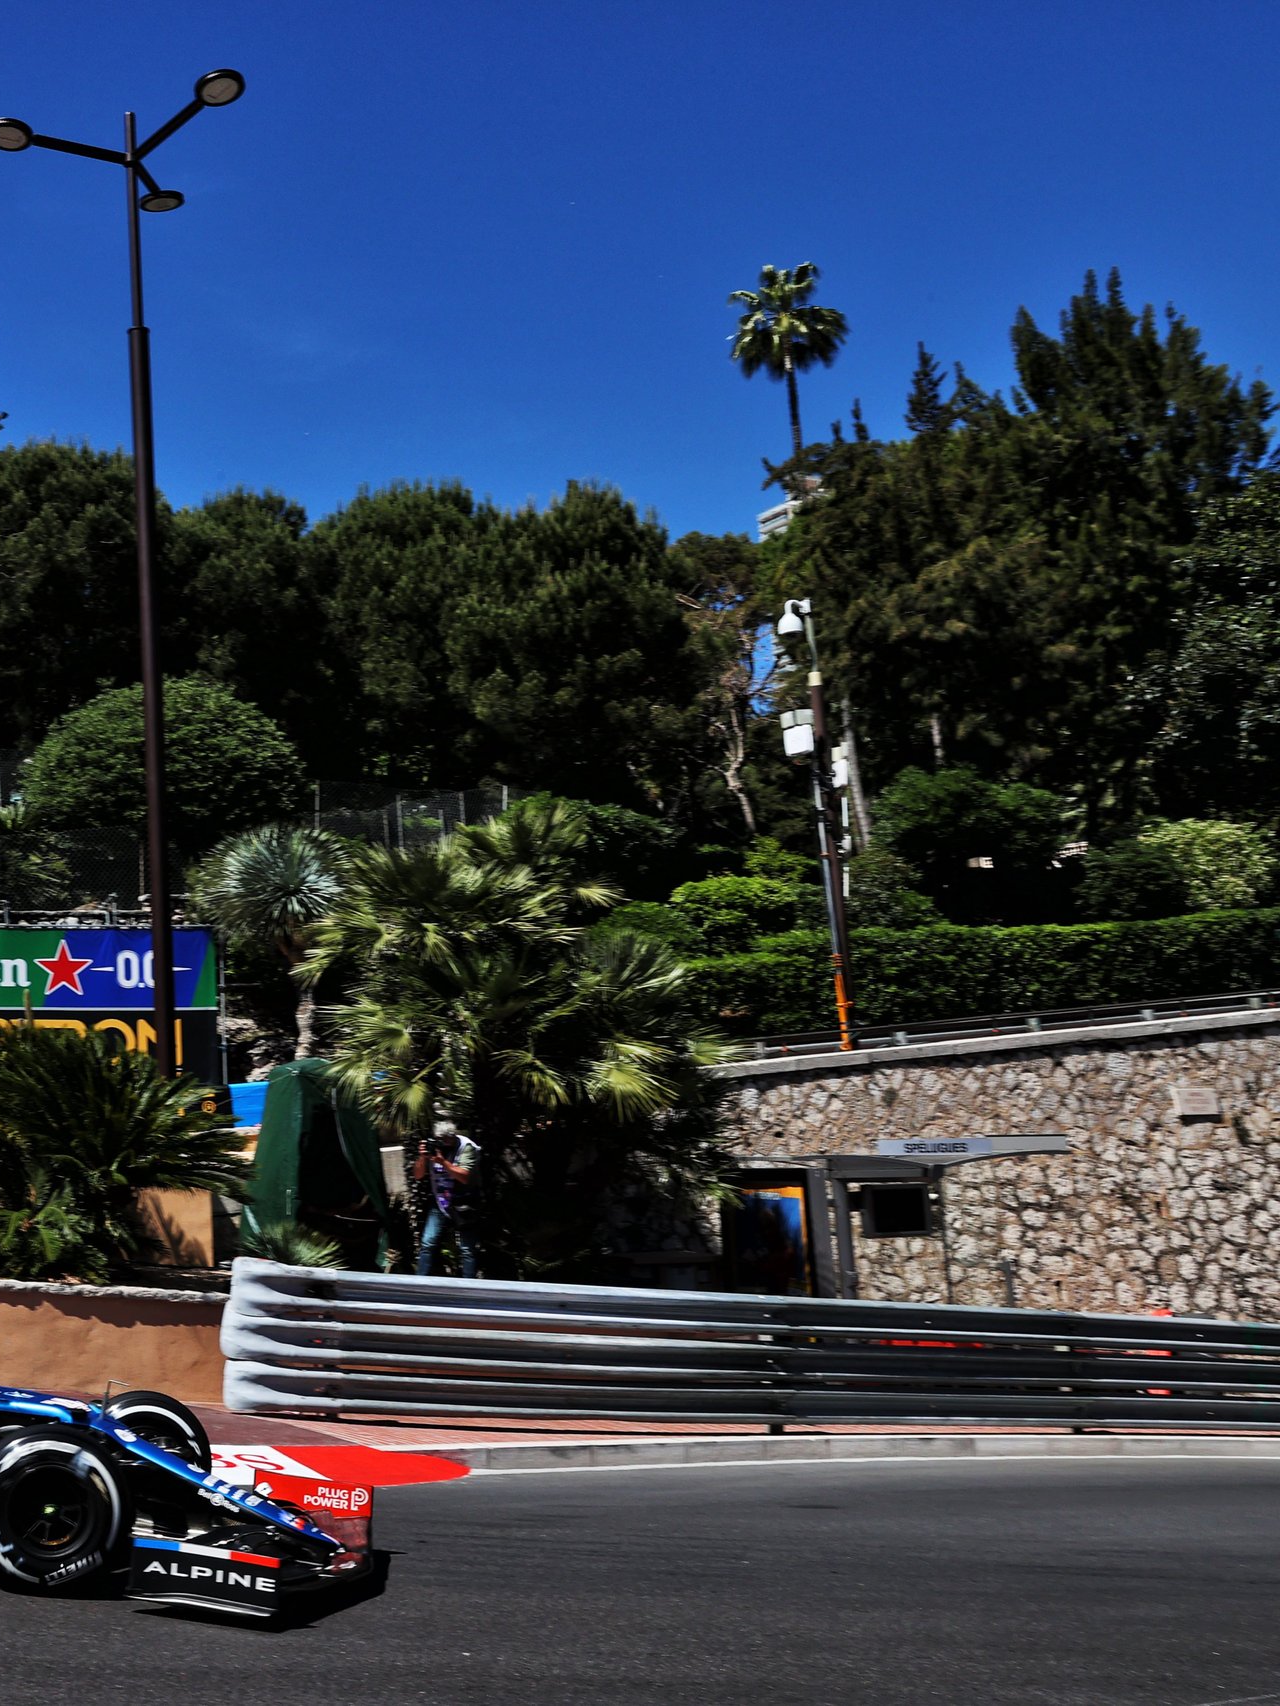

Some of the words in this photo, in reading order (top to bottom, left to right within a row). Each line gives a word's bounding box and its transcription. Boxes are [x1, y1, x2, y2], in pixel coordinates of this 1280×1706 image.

[317, 1487, 349, 1499] PLUG
[303, 1495, 348, 1510] POWER
[143, 1561, 276, 1593] ALPINE
